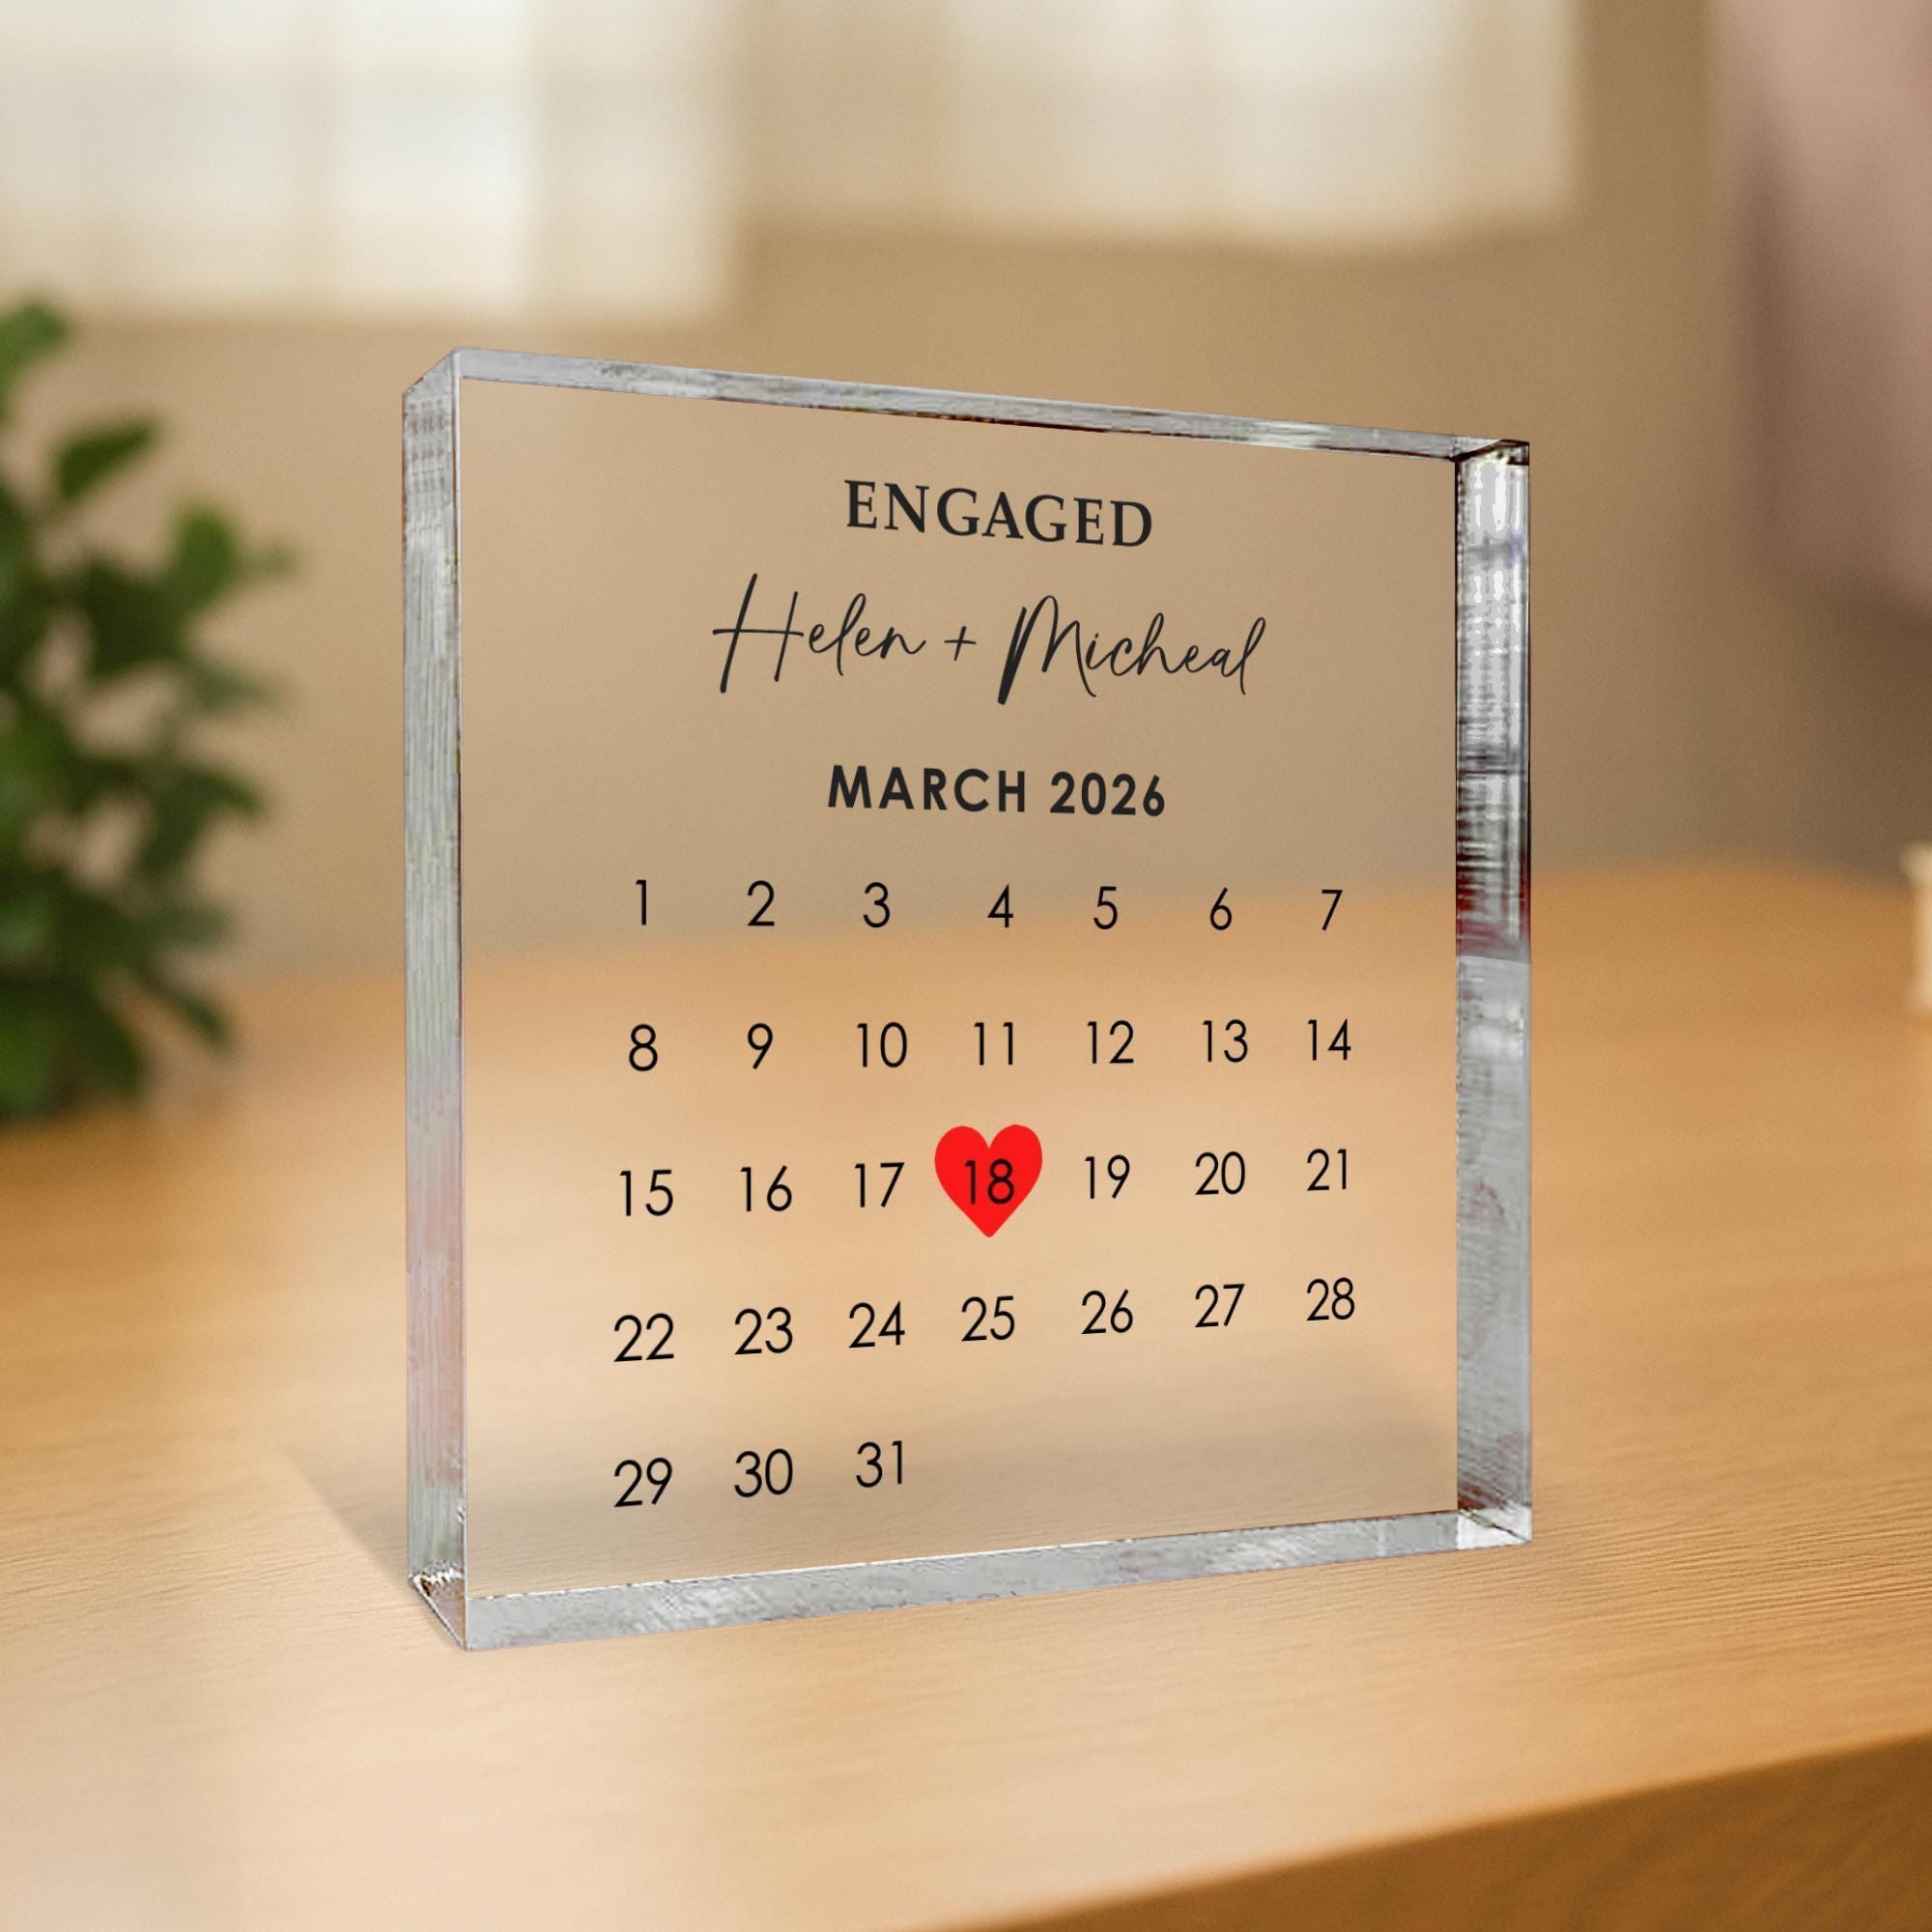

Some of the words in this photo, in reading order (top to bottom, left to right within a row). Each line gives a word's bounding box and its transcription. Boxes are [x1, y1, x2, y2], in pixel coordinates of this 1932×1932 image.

[844, 479, 1152, 548] ENGAGED
[712, 573, 926, 694] Helen
[944, 625, 977, 662] +
[997, 595, 1266, 705] Micheal
[828, 764, 1026, 812] MARCH
[1049, 771, 1165, 817] 2026
[635, 879, 647, 926] 1
[747, 880, 775, 927] 2
[863, 881, 891, 928] 3
[987, 884, 1014, 928] 4
[1093, 885, 1119, 930] 5
[1209, 887, 1233, 931] 6
[1321, 889, 1344, 931] 7
[628, 1023, 659, 1072] 8
[747, 1022, 774, 1069] 9
[857, 1021, 908, 1068] 10
[974, 1021, 1013, 1066] 11
[1087, 1019, 1134, 1065] 12
[1203, 1019, 1248, 1064] 13
[1307, 1018, 1351, 1061] 14
[619, 1169, 673, 1216] 15
[740, 1165, 792, 1212] 16
[854, 1162, 905, 1208] 17
[966, 1158, 1014, 1205] 18
[1085, 1154, 1130, 1200] 19
[1195, 1151, 1246, 1196] 20
[1306, 1148, 1347, 1191] 21
[613, 1313, 674, 1363] 22
[734, 1306, 793, 1355] 23
[848, 1301, 906, 1349] 24
[961, 1295, 1015, 1342] 25
[1081, 1289, 1133, 1335] 26
[1194, 1283, 1245, 1328] 27
[1306, 1277, 1355, 1321] 28
[613, 1457, 673, 1508] 29
[734, 1448, 793, 1498] 30
[856, 1440, 903, 1489] 31
